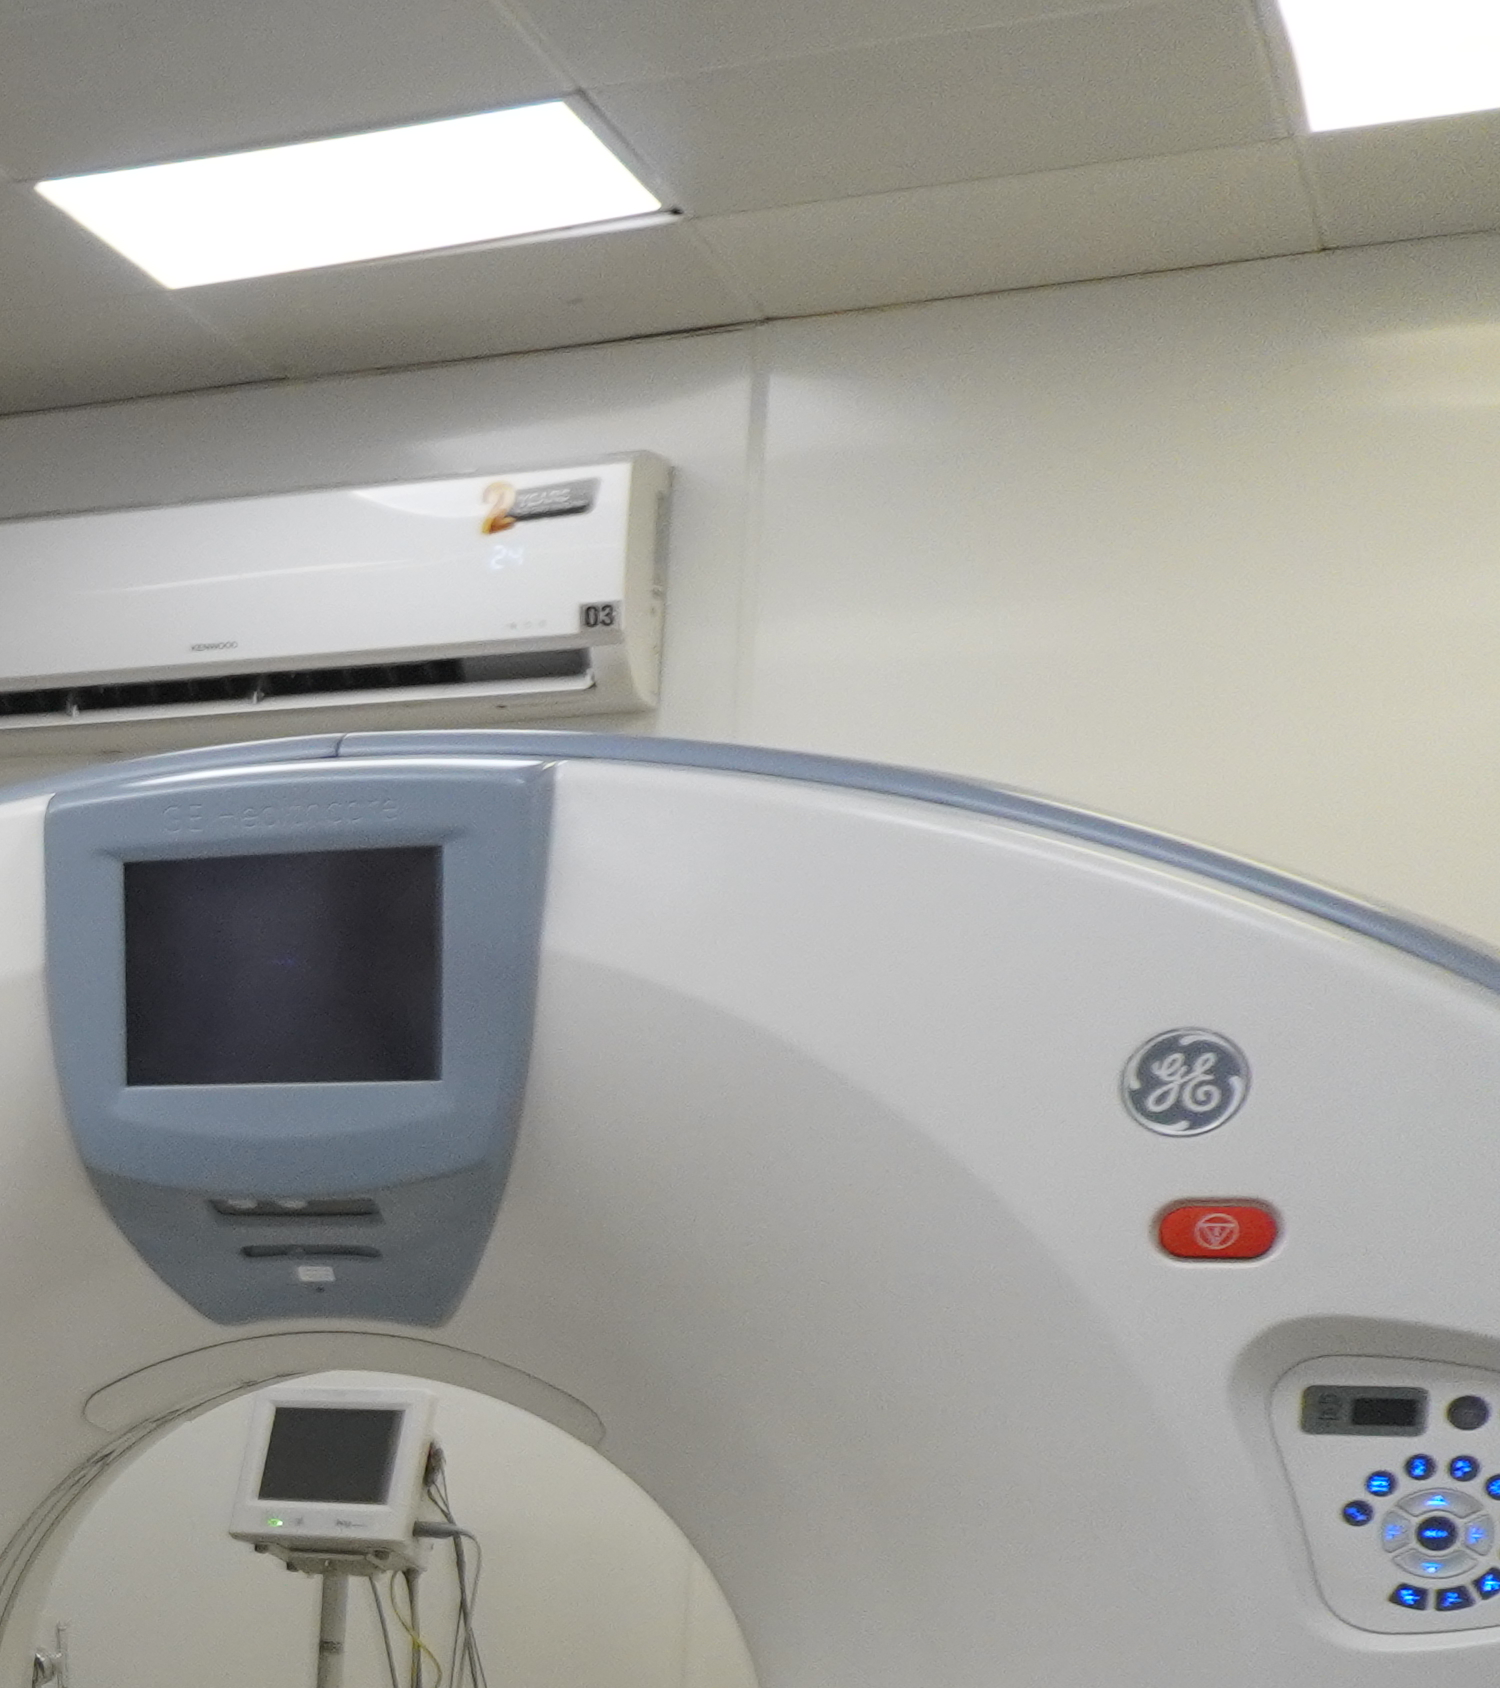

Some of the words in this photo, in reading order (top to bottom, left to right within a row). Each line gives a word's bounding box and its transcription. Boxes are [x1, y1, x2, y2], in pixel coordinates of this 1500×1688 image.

[481, 481, 516, 535] 2
[584, 604, 615, 627] 03
[1146, 1052, 1222, 1113] GE
